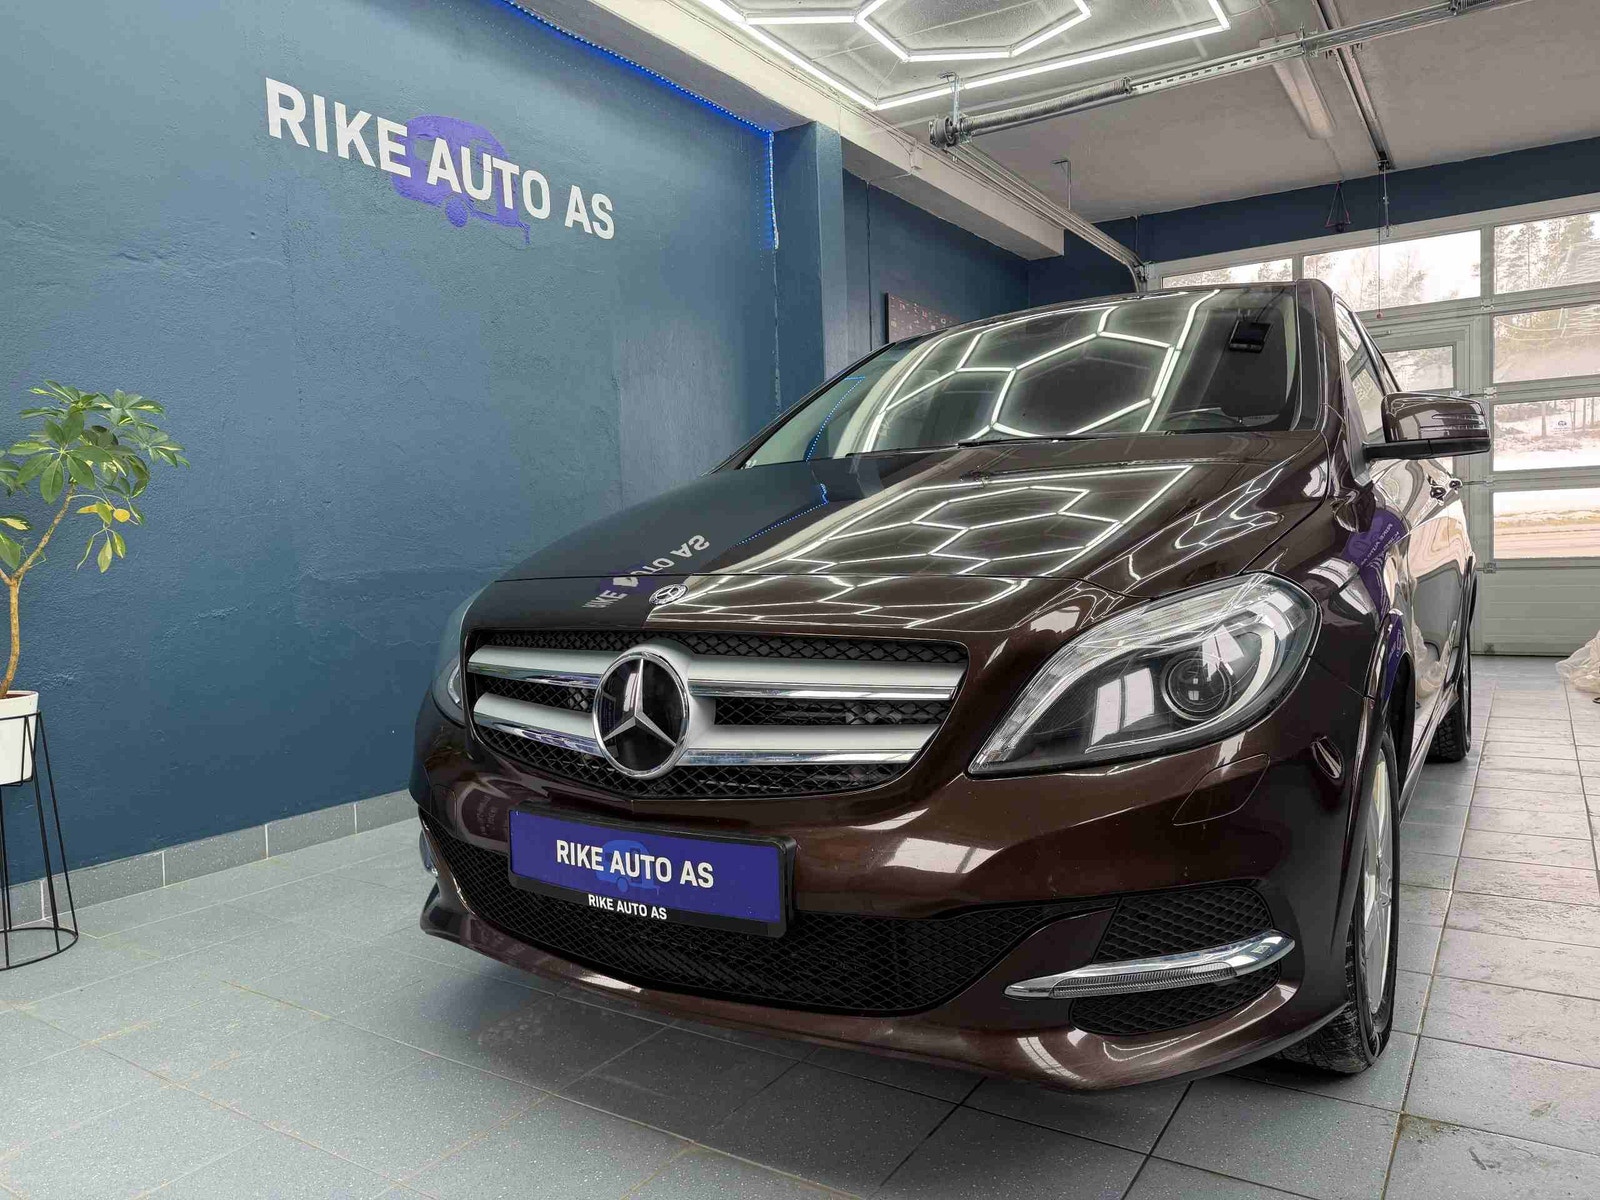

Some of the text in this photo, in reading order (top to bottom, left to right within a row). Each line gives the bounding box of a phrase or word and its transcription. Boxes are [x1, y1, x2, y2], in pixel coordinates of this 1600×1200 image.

[265, 77, 615, 240] RIKE AUTO AS
[556, 839, 714, 888] RIKE AUTO AS
[588, 894, 667, 920] RIKE AUTO AS
